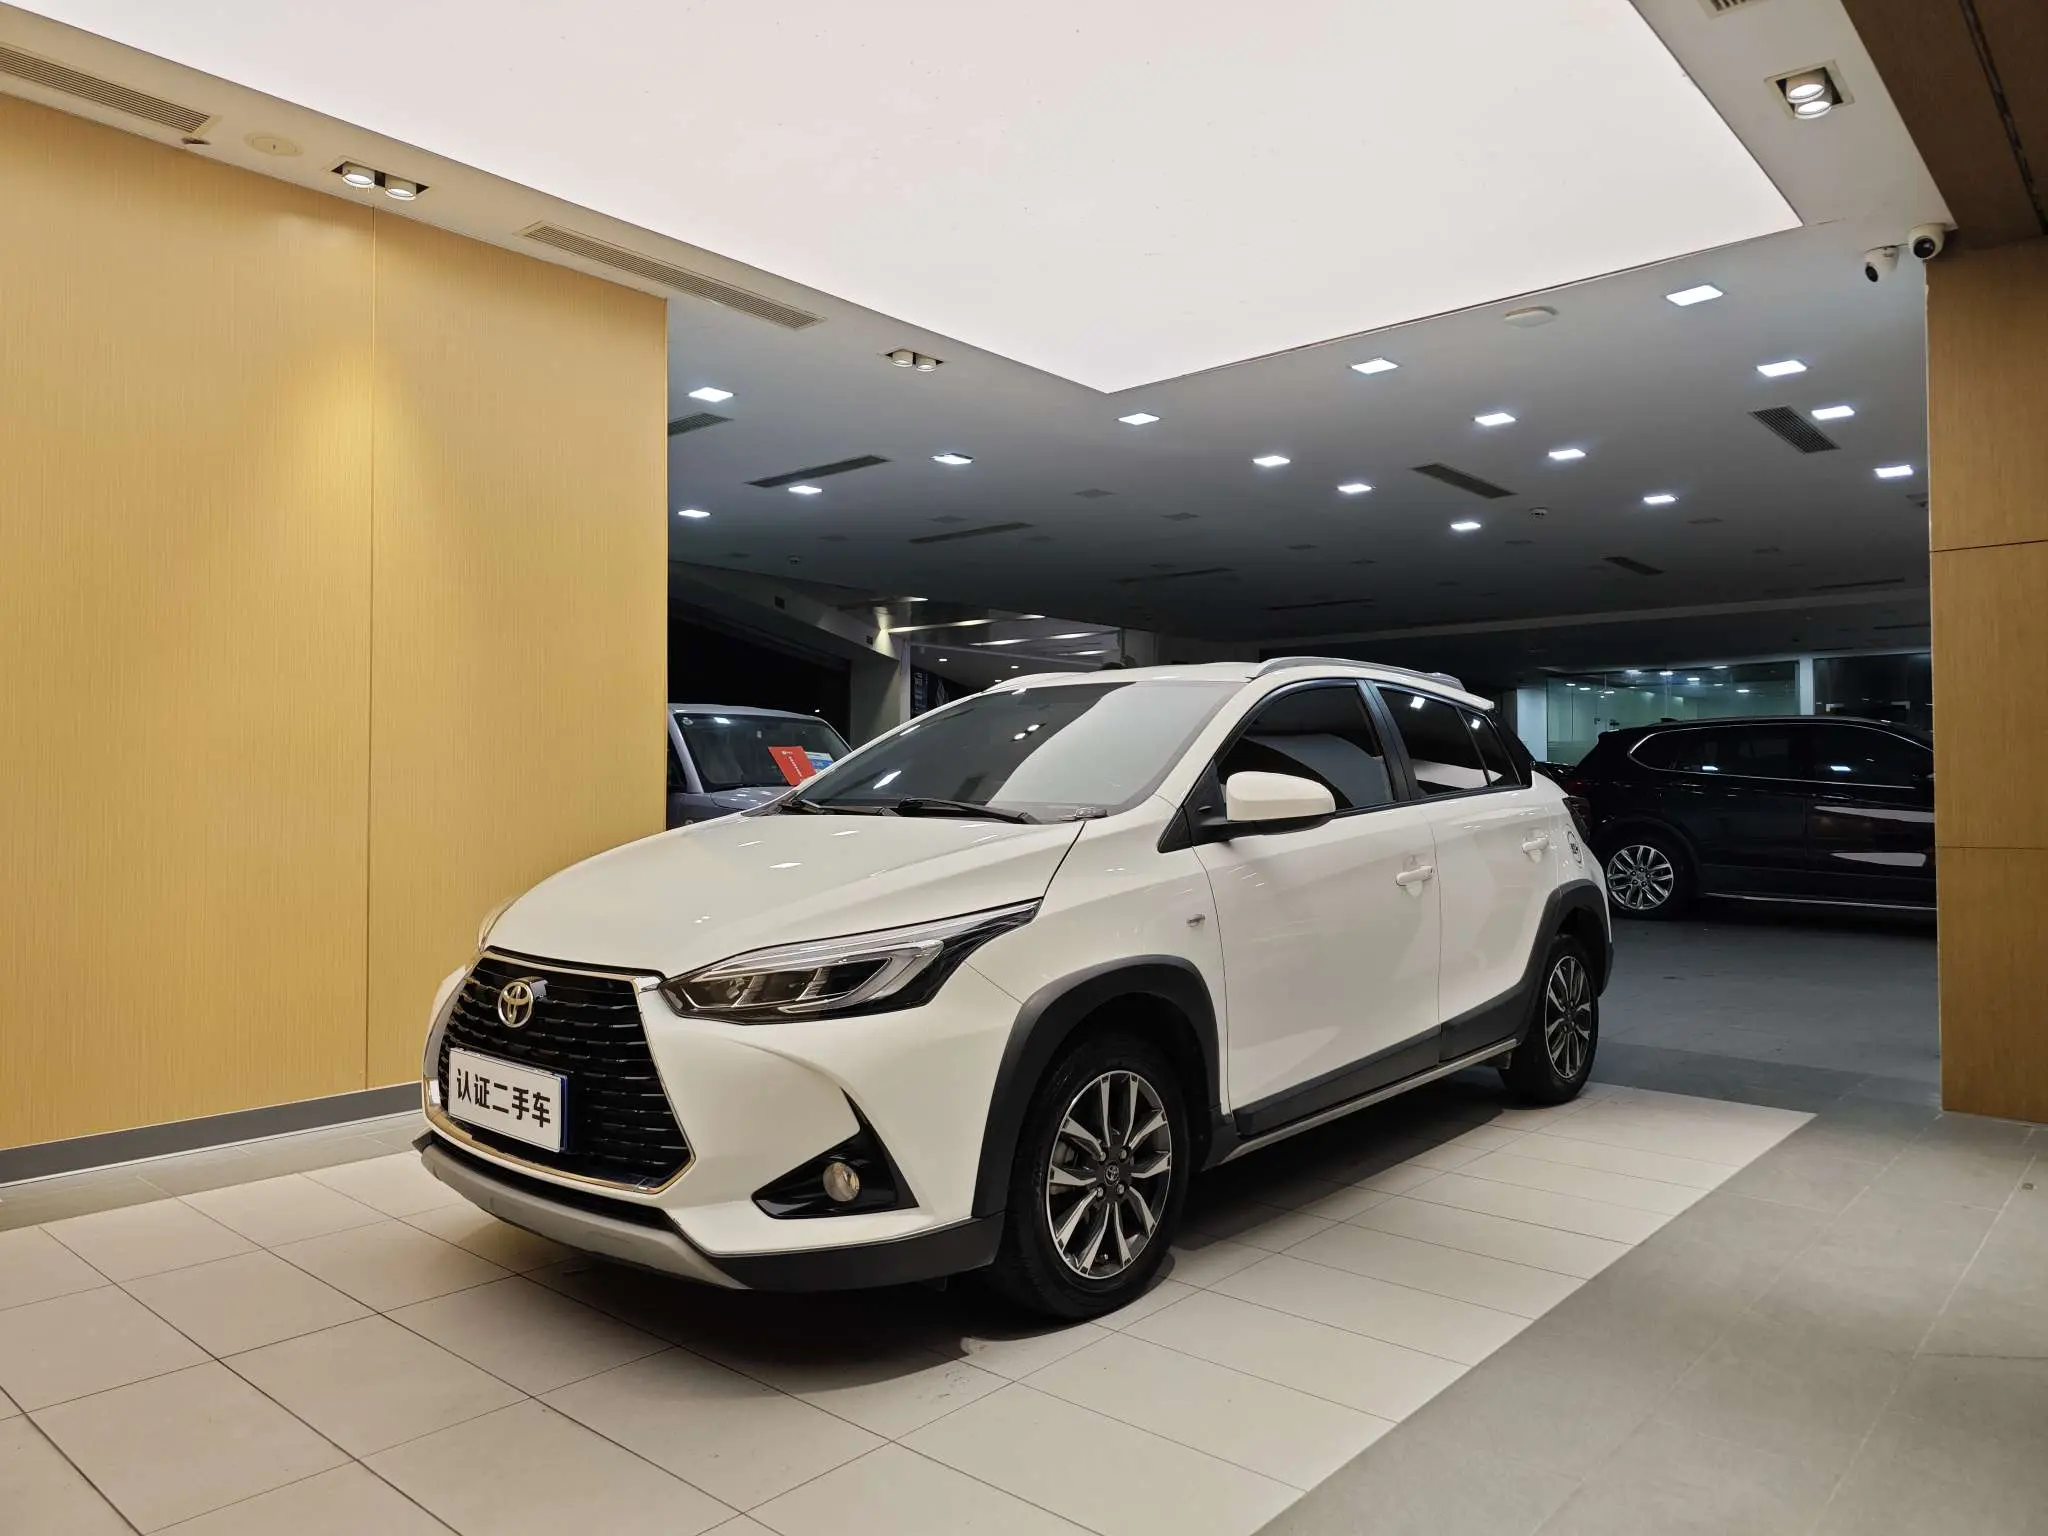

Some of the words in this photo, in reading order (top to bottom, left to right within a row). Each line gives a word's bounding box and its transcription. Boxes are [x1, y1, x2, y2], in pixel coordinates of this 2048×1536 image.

[457, 1068, 551, 1128] 认证二手车
